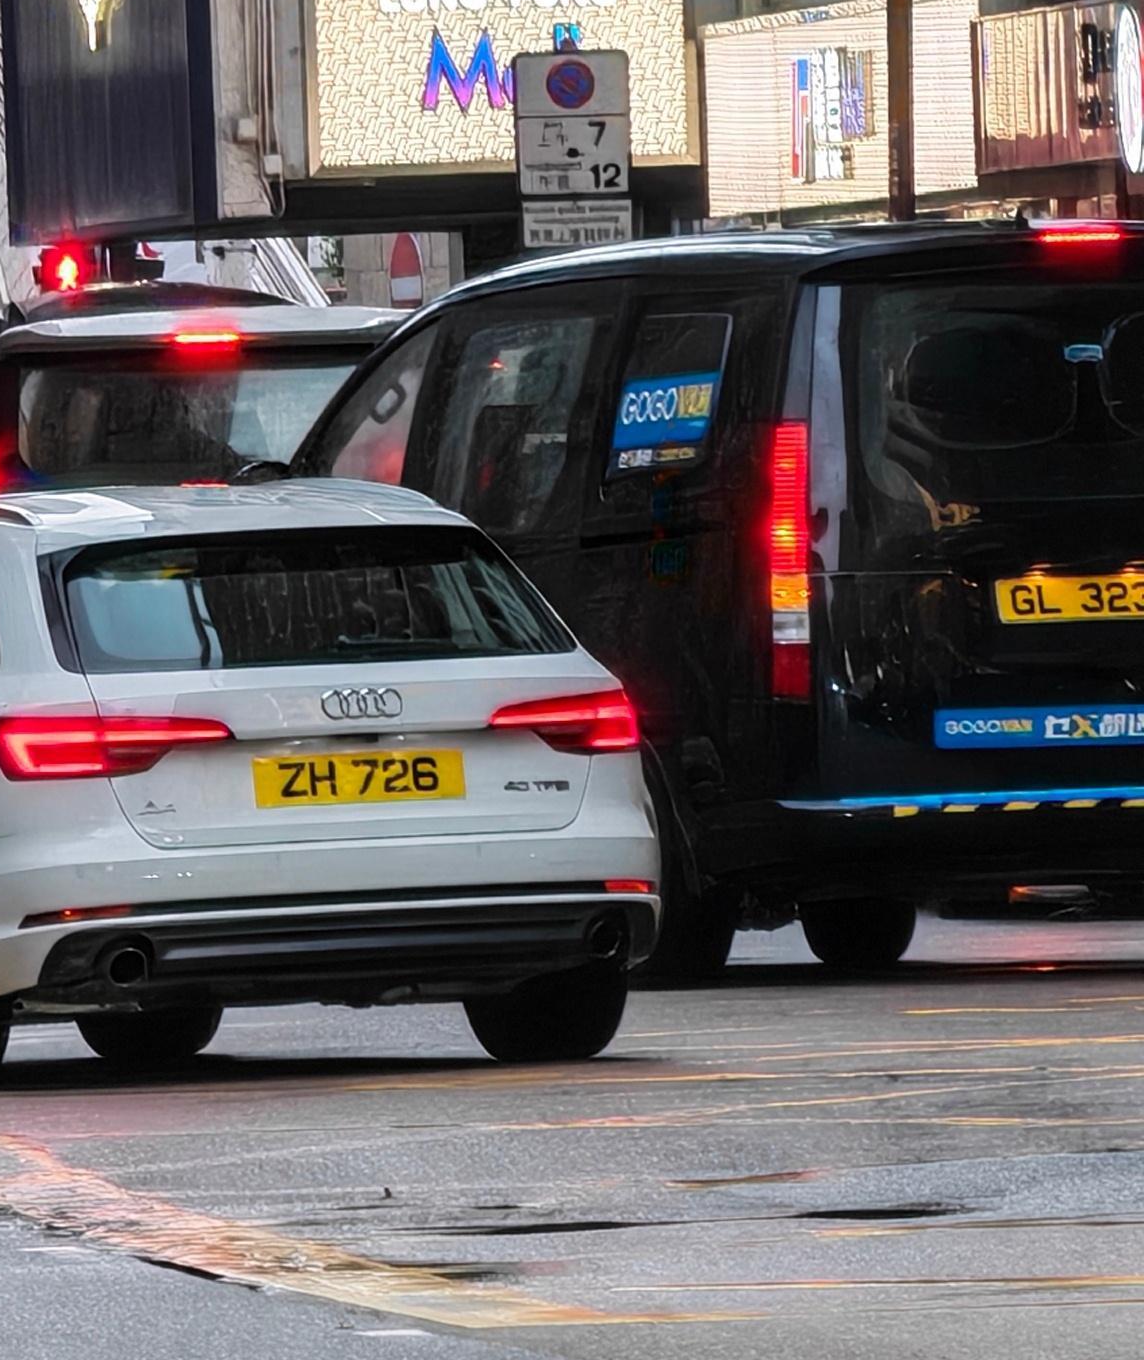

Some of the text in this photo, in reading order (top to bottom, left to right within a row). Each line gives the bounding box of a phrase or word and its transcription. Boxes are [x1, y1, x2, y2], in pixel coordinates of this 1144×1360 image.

[588, 120, 607, 147] 7
[590, 162, 622, 189] 12
[1009, 584, 1063, 616] GL
[277, 756, 440, 799] ZH 726
